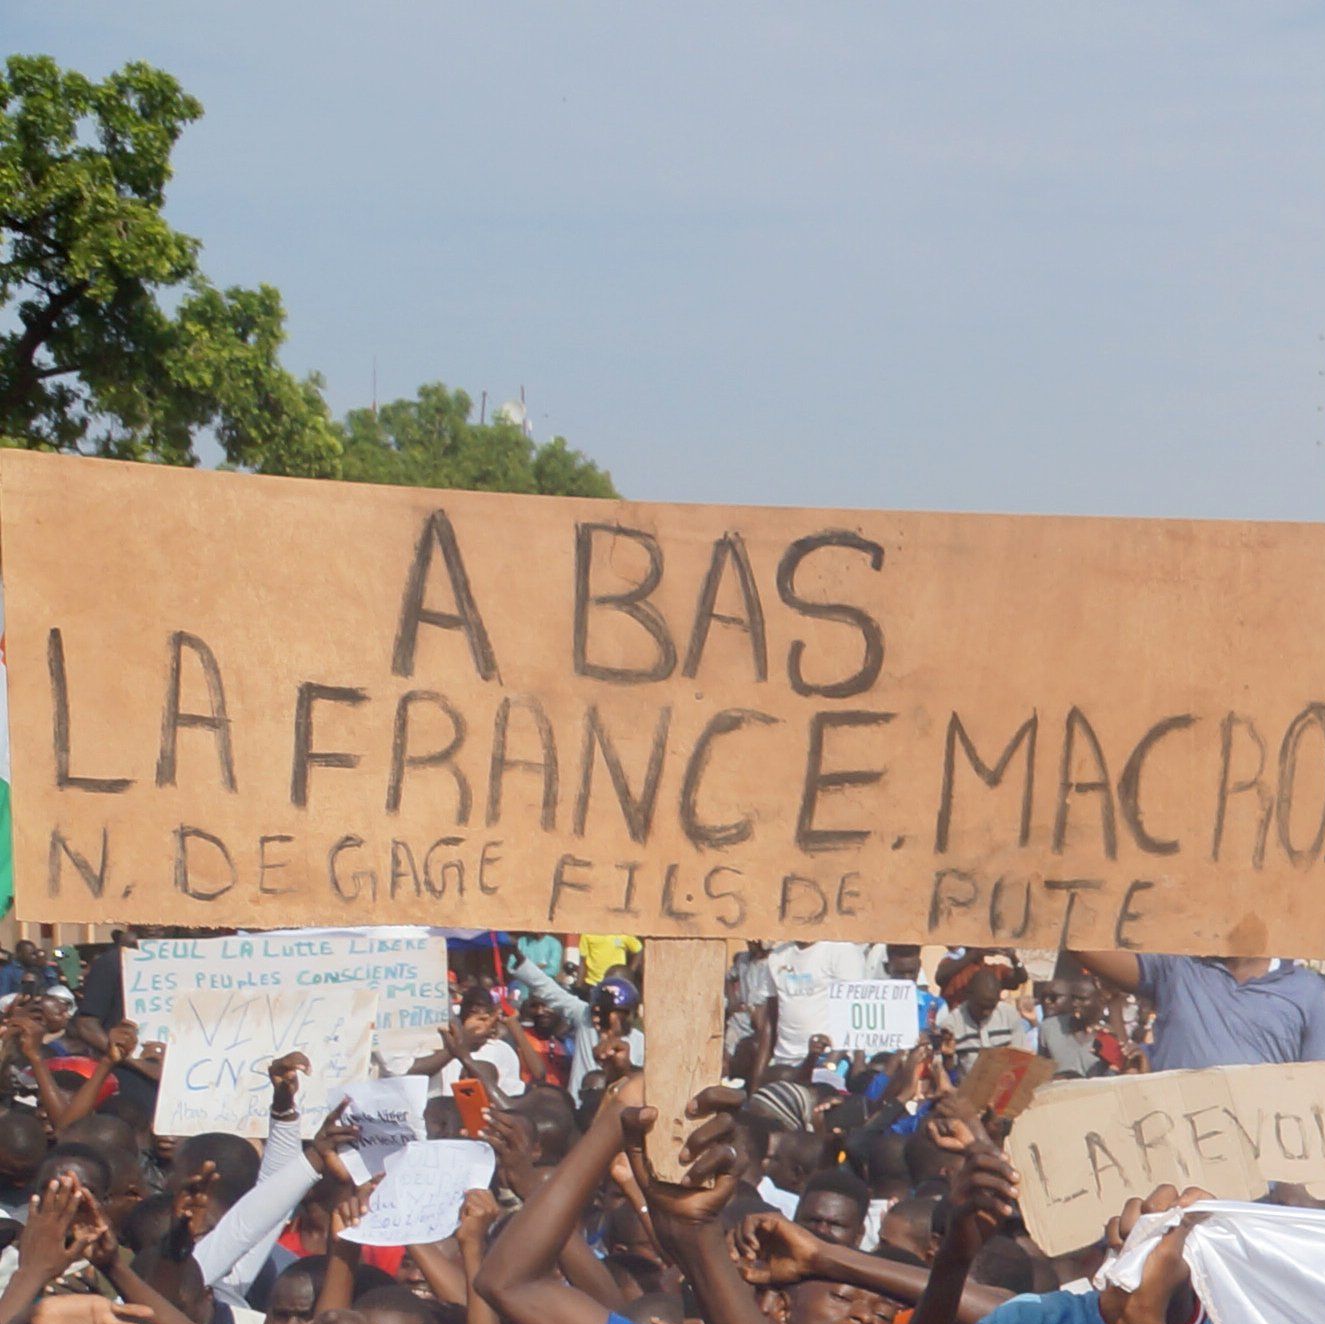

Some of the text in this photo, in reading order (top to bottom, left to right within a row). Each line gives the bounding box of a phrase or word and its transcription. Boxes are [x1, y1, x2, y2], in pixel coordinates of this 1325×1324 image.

[392, 508, 886, 699] A BAS
[47, 627, 238, 793] LA
[548, 851, 747, 928] FILS
[777, 870, 861, 926] DE
[926, 866, 1155, 952] PUTE
[133, 937, 206, 962] SEUL
[221, 939, 255, 960] LA
[130, 970, 178, 992] LES
[829, 984, 911, 1000] LE PEUPLE DIT
[187, 992, 326, 1052] VIVE
[851, 1003, 885, 1030] OUI
